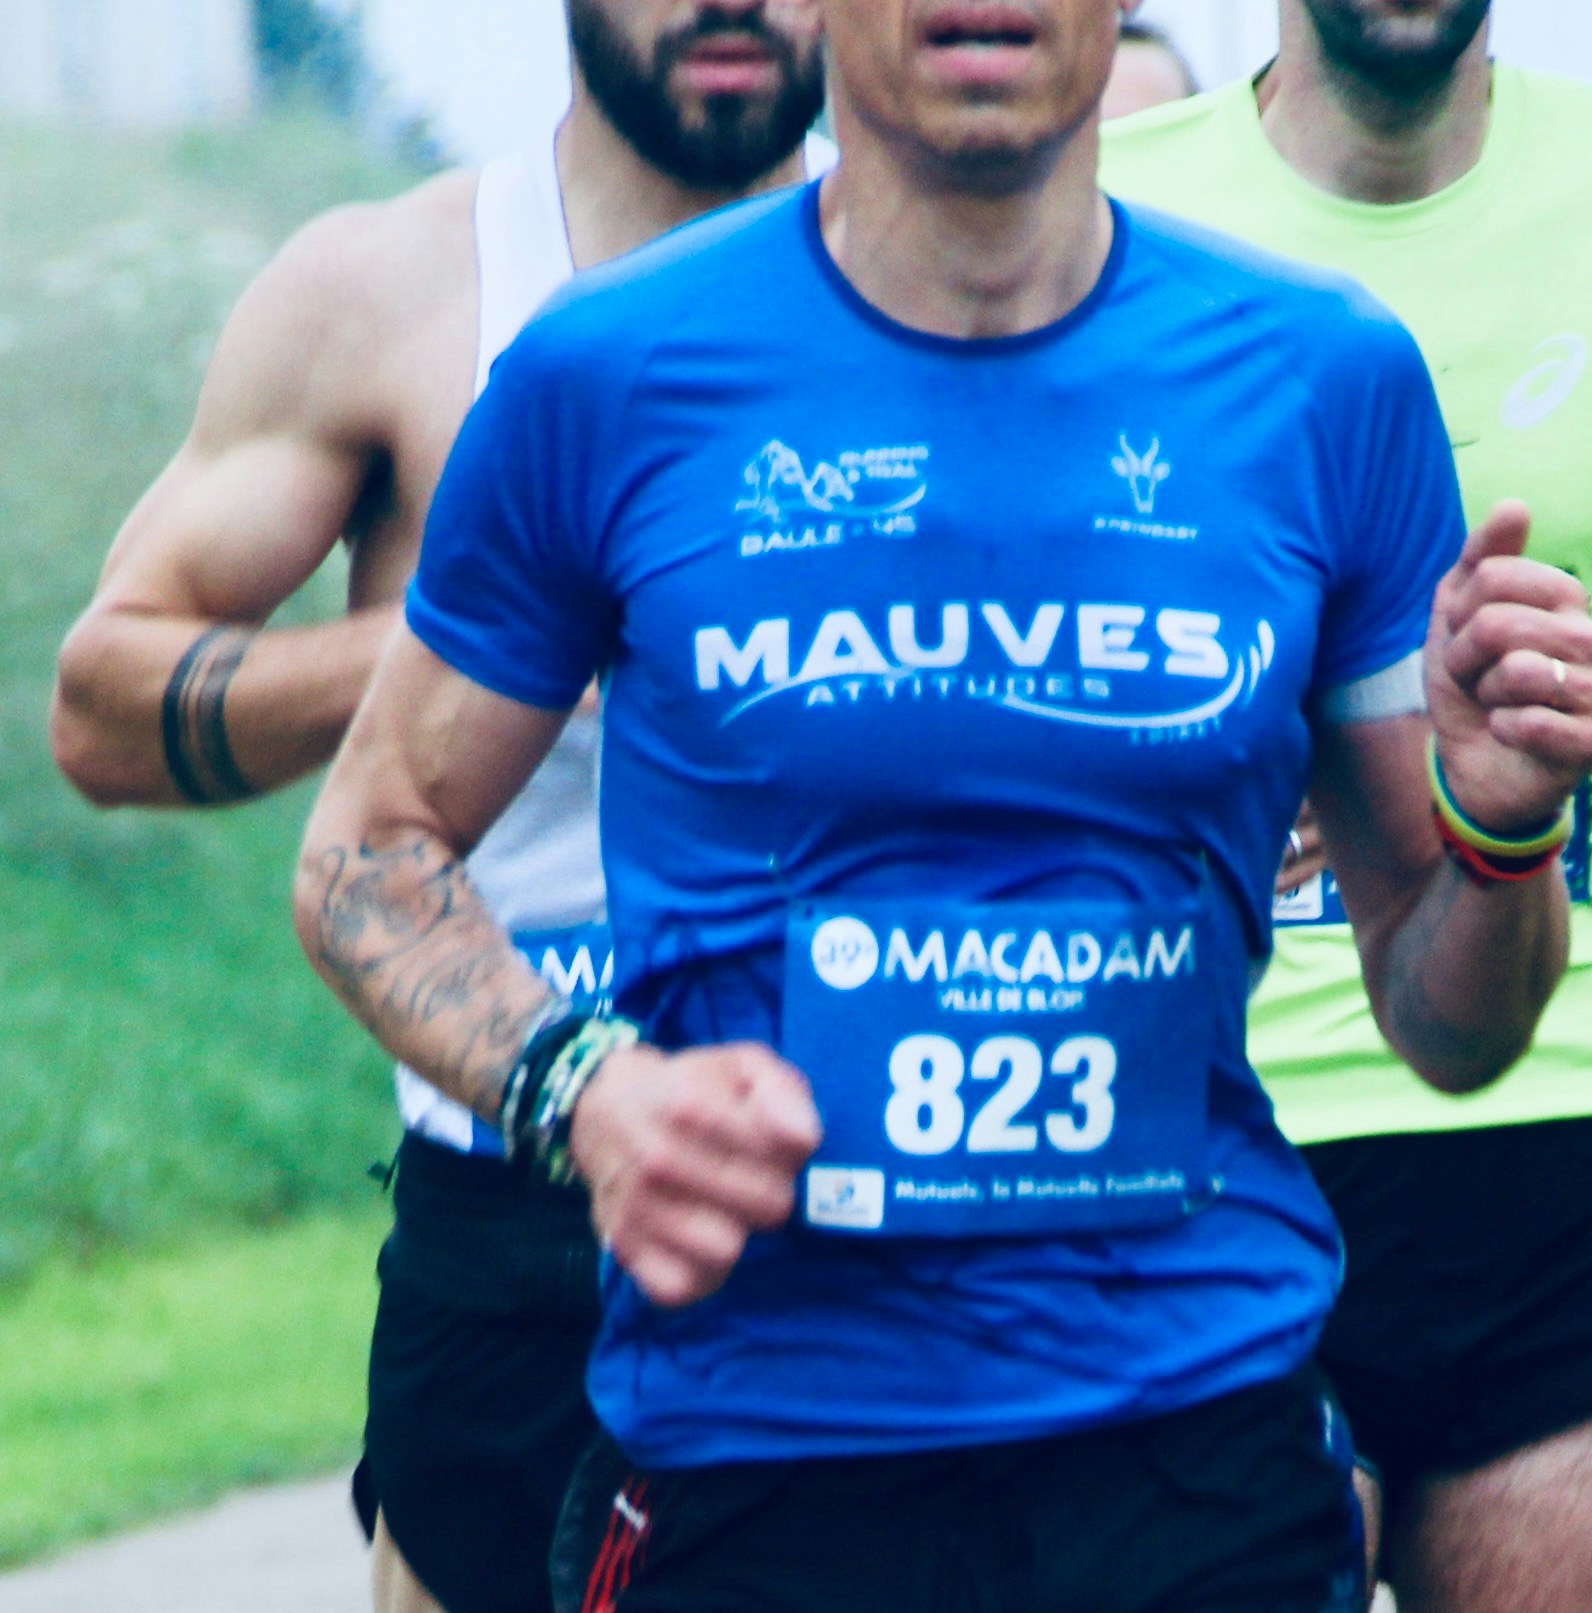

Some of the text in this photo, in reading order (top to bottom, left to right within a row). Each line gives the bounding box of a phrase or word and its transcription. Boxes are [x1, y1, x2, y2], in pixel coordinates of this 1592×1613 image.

[694, 602, 1229, 690] MAUVES
[806, 675, 1111, 706] ATTITUDES
[884, 926, 1195, 984] MACADAM
[996, 986, 1022, 1012] DE
[884, 1033, 1117, 1156] 823
